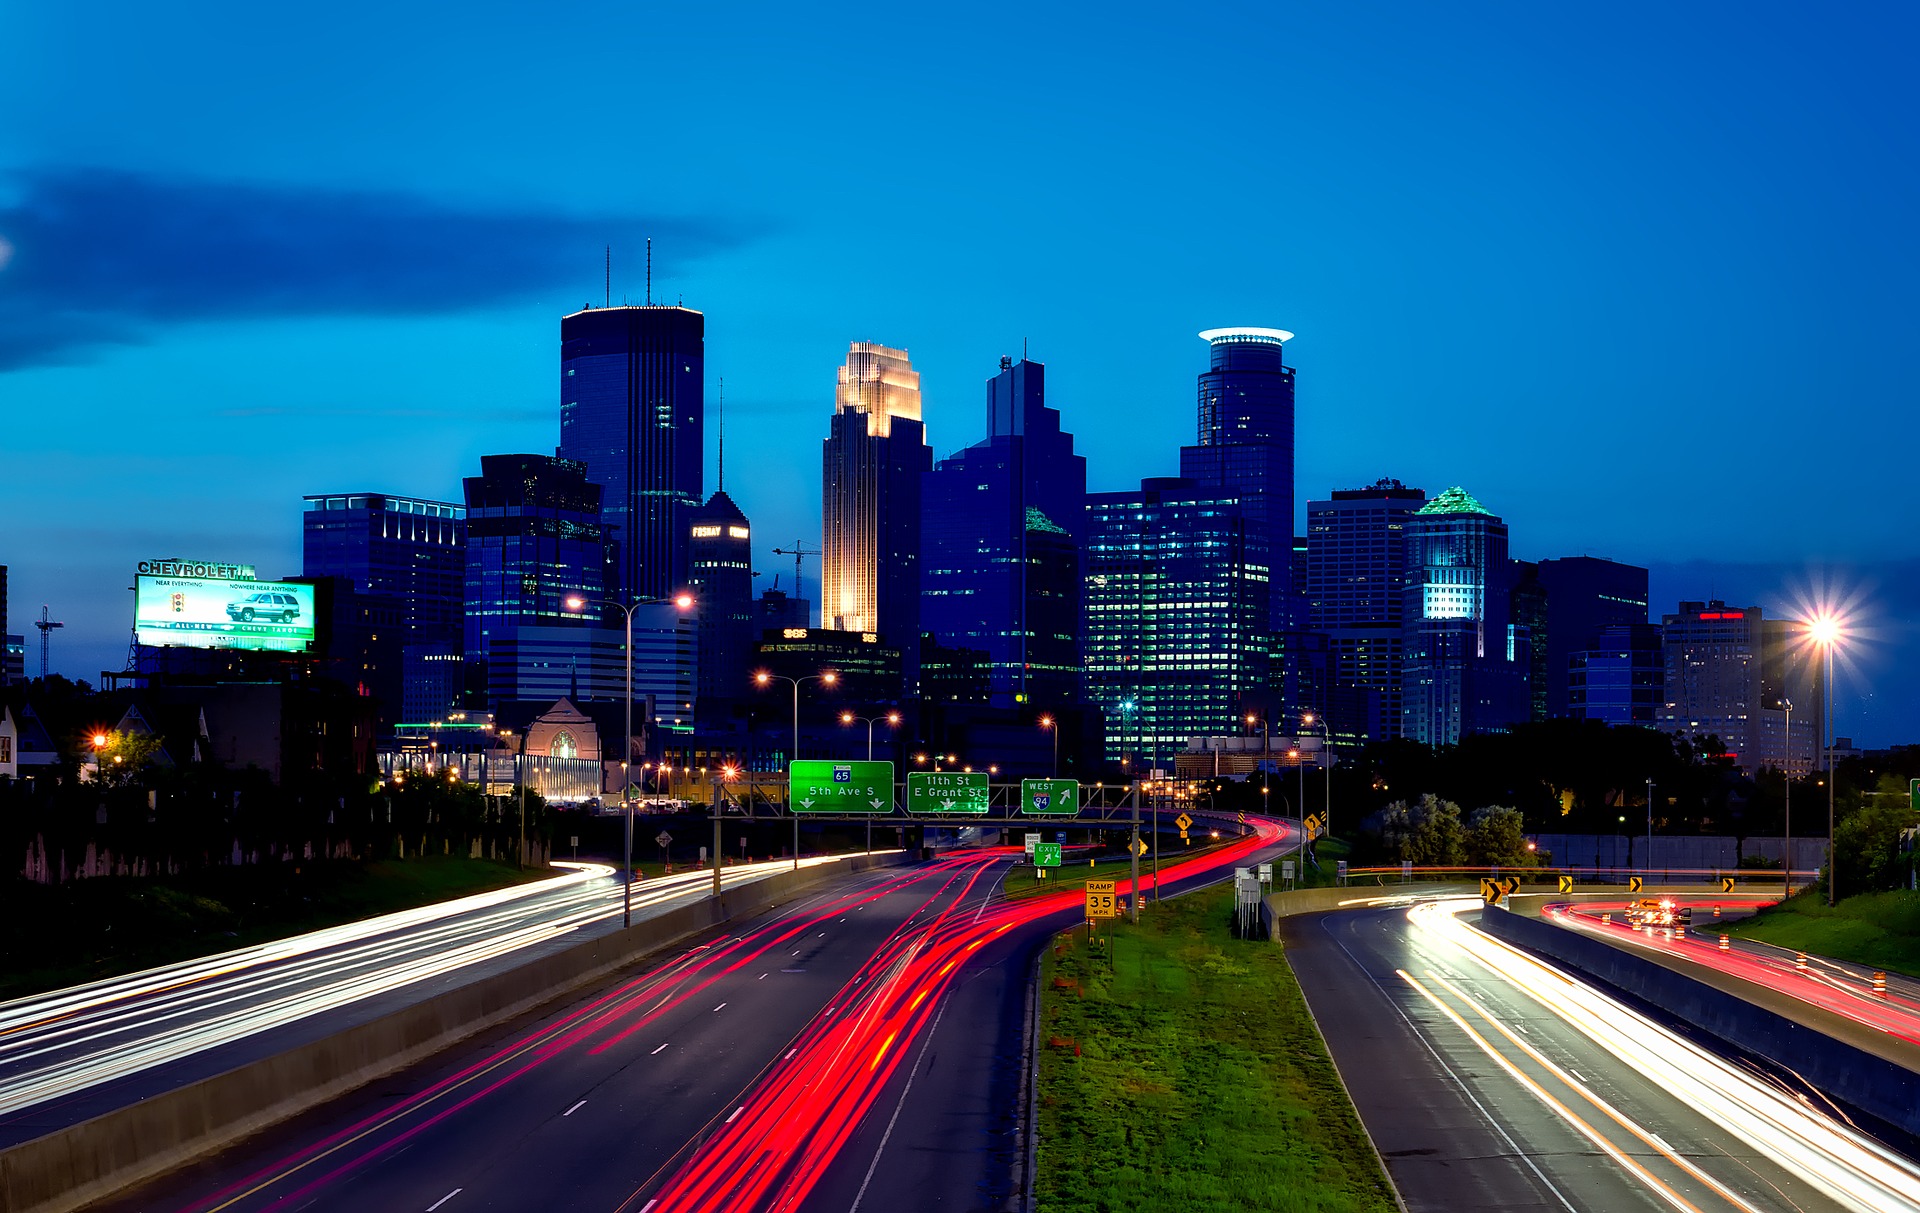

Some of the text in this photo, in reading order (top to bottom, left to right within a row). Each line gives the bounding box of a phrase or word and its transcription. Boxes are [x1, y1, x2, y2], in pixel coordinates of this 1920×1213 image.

[138, 562, 237, 578] CHEVROLET
[835, 772, 849, 781] 65
[926, 776, 970, 786] 11th St
[809, 786, 874, 796] 5th Ave S
[914, 788, 982, 797] E Grant St
[1035, 797, 1047, 806] 94
[1090, 896, 1111, 908] 35
